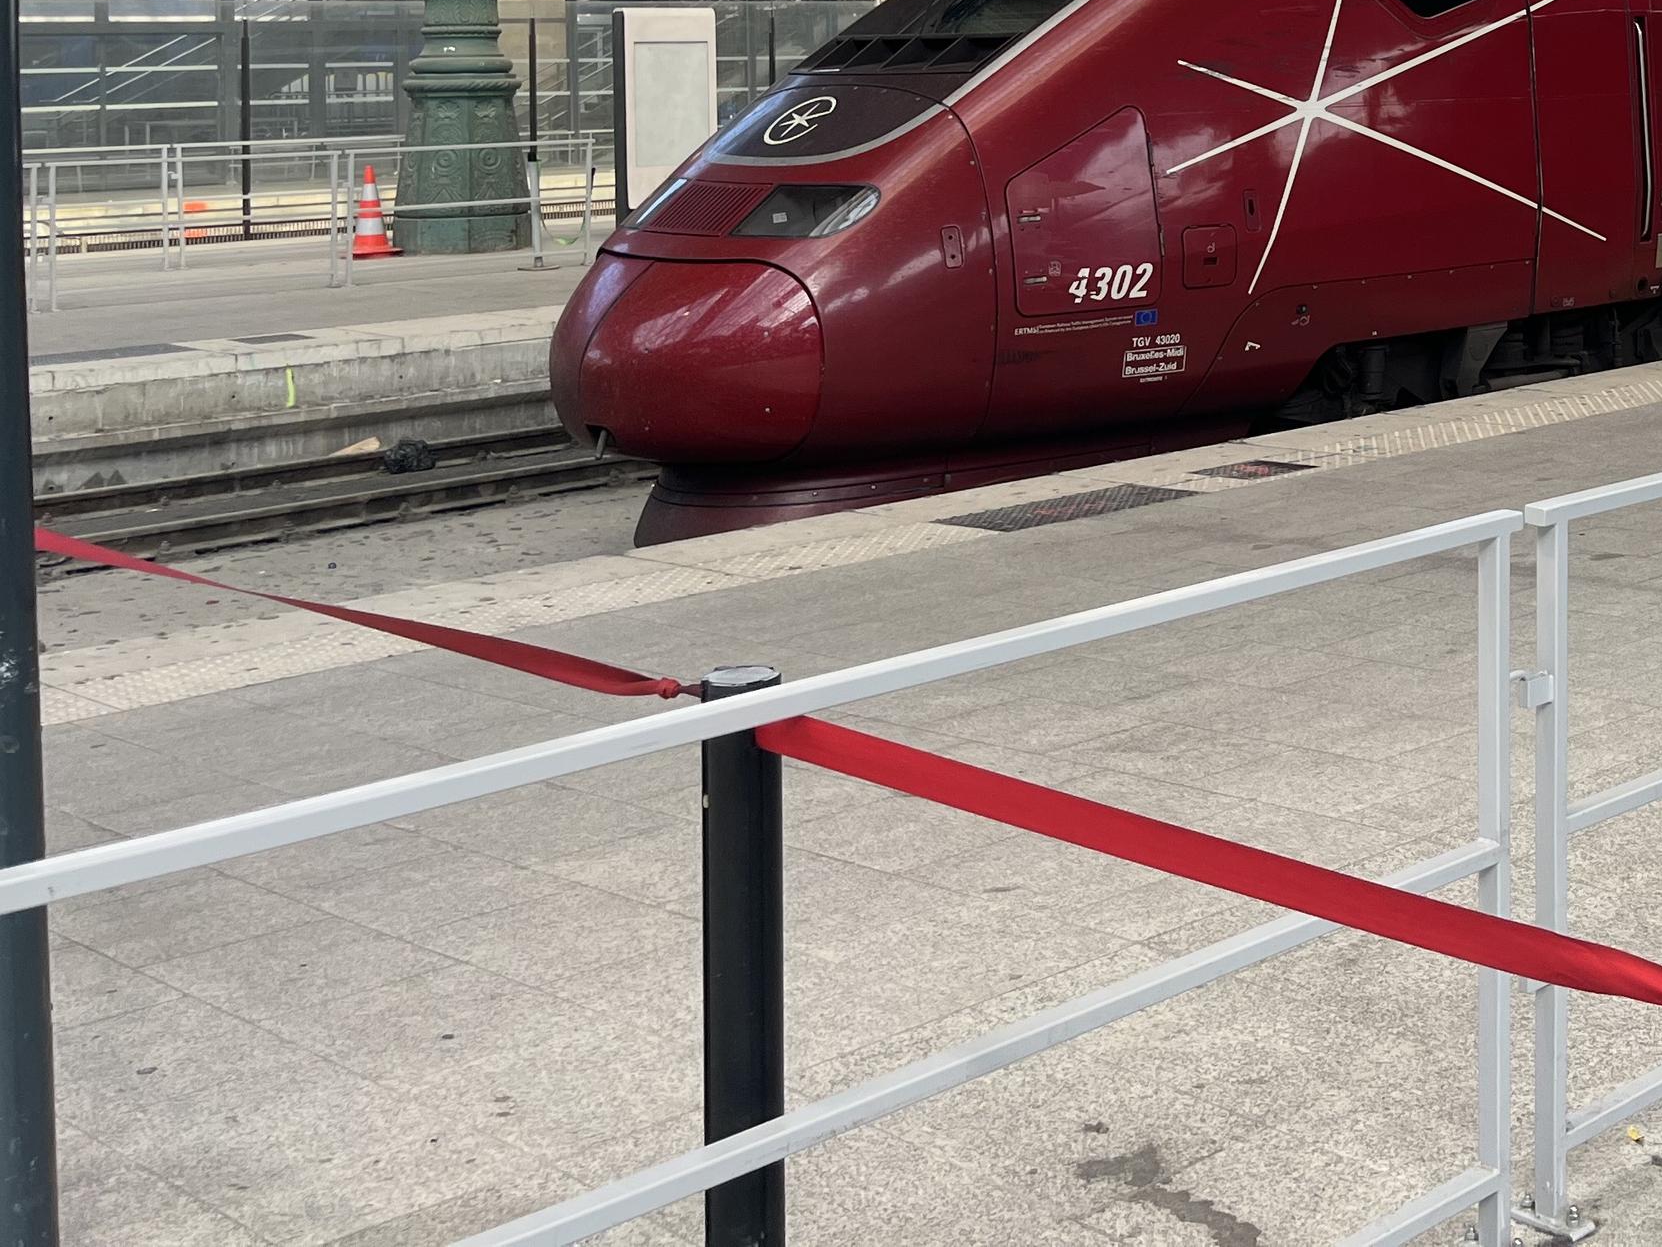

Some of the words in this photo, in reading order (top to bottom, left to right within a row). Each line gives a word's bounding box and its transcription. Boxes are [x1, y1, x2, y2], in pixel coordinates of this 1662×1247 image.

[1069, 263, 1154, 303] 4302
[1132, 336, 1151, 347] TGV
[1155, 333, 1181, 345] 43020
